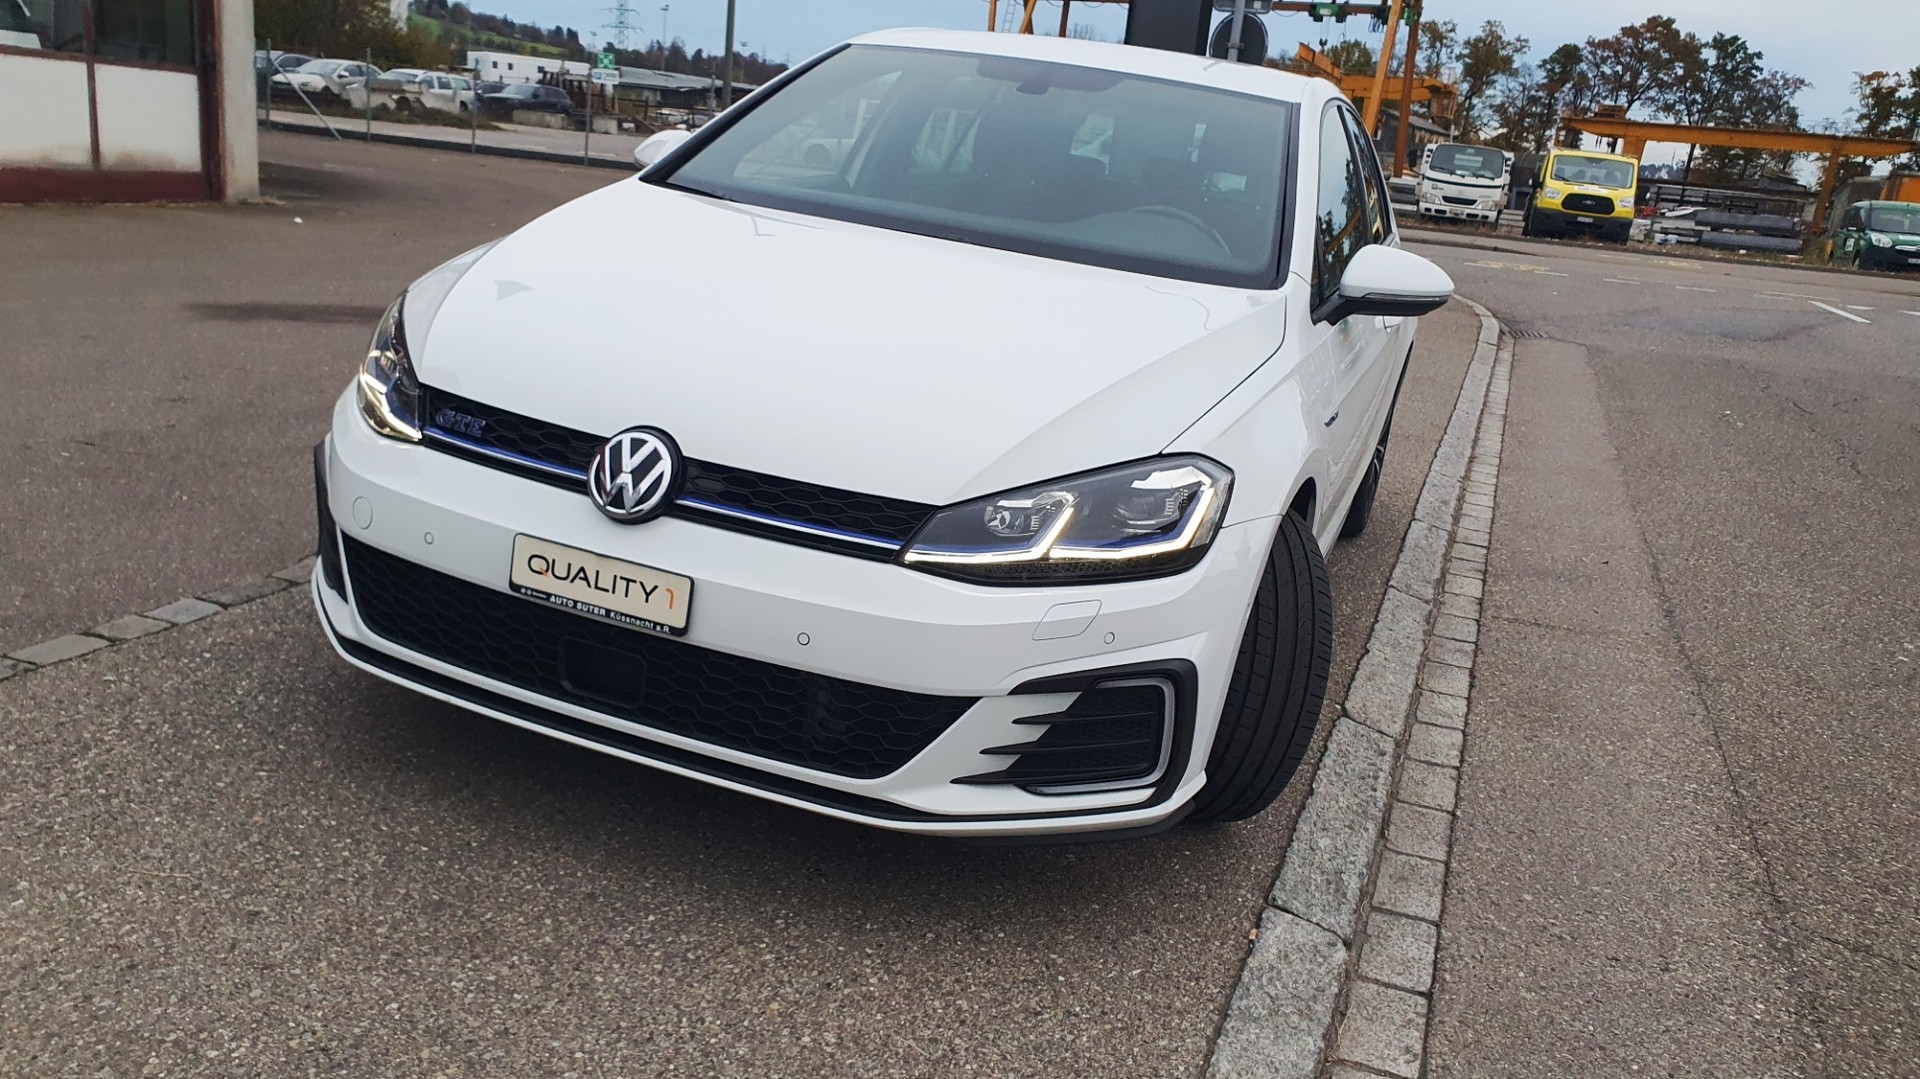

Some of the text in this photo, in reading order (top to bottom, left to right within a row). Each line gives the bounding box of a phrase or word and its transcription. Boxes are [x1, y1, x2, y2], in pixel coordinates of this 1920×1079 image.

[435, 408, 487, 438] GTE
[527, 554, 660, 604] QUALITY
[549, 594, 574, 608] AUTO
[576, 601, 607, 617] SUTER
[609, 611, 655, 631] Küssnacht
